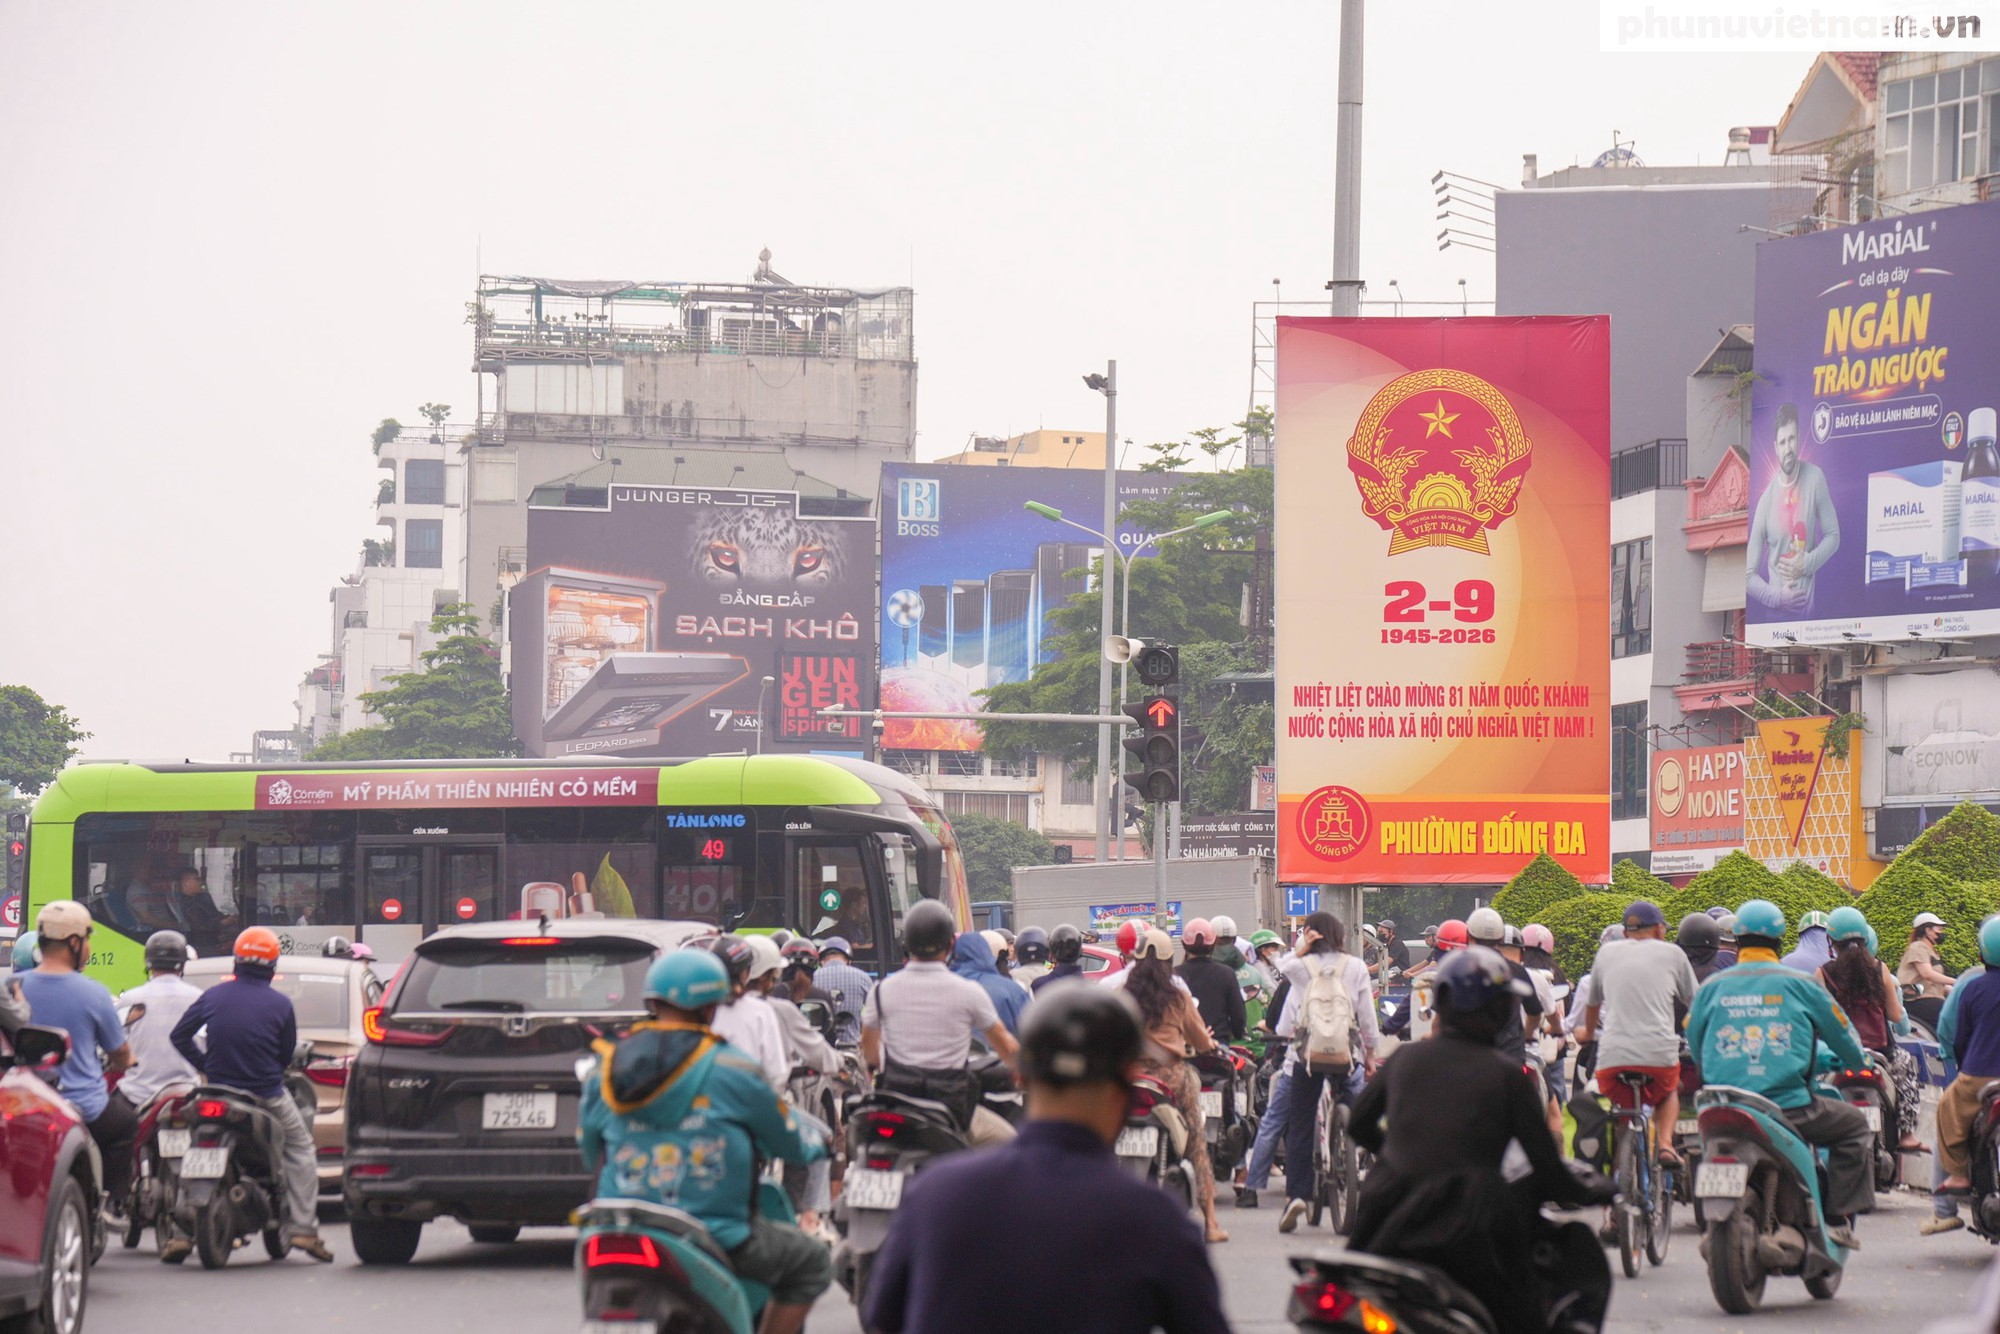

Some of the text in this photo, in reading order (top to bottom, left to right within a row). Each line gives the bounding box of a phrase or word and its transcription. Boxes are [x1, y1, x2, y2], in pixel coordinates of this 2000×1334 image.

[1859, 266, 1909, 287] Gel dạ dày
[1824, 288, 1932, 356] NGĂN
[1813, 346, 1948, 396] TRÀO NGƯỢC
[1835, 404, 1938, 429] BẢO VỆ & LÀM LÀNH NIÊM MẠC
[1142, 486, 1159, 495] mát
[1412, 521, 1466, 534] VIỆT NAM
[719, 588, 815, 607] ĐẲNG CẤP
[1383, 580, 1495, 623] 2-9
[676, 612, 859, 643] SẠCH KHÔ
[1381, 629, 1495, 643] 1945-2026
[783, 656, 855, 682] JUN
[783, 681, 861, 708] GER
[1294, 677, 1589, 712] NHIỆT LIỆT CHÀO MỪNG 81 NĂM QUỐC KHÁNH
[709, 708, 732, 731] 7
[1288, 709, 1594, 743] NƯỚC CỘNG HÒA XÃ HỘI CHỦ NGHĨA VIỆT NAM !
[566, 738, 627, 753] LEOPARD
[1916, 748, 1979, 768] ECONOW
[343, 775, 637, 801] MỸ PHẨM THIÊN NHIÊN CỎ MỀM
[800, 822, 812, 830] LÊN
[1245, 822, 1263, 831] CÔNG
[1380, 811, 1586, 855] PHƯỜNG ĐỐNG ĐA
[702, 839, 725, 860] 49
[1184, 844, 1198, 858] SẢN
[1200, 844, 1212, 858] HẢI
[1314, 842, 1355, 857] ĐỐNG ĐA
[1721, 995, 1763, 1007] GREEN
[1728, 1009, 1745, 1018] Xin
[505, 1093, 535, 1109] 30H
[492, 1110, 546, 1127] 725.46
